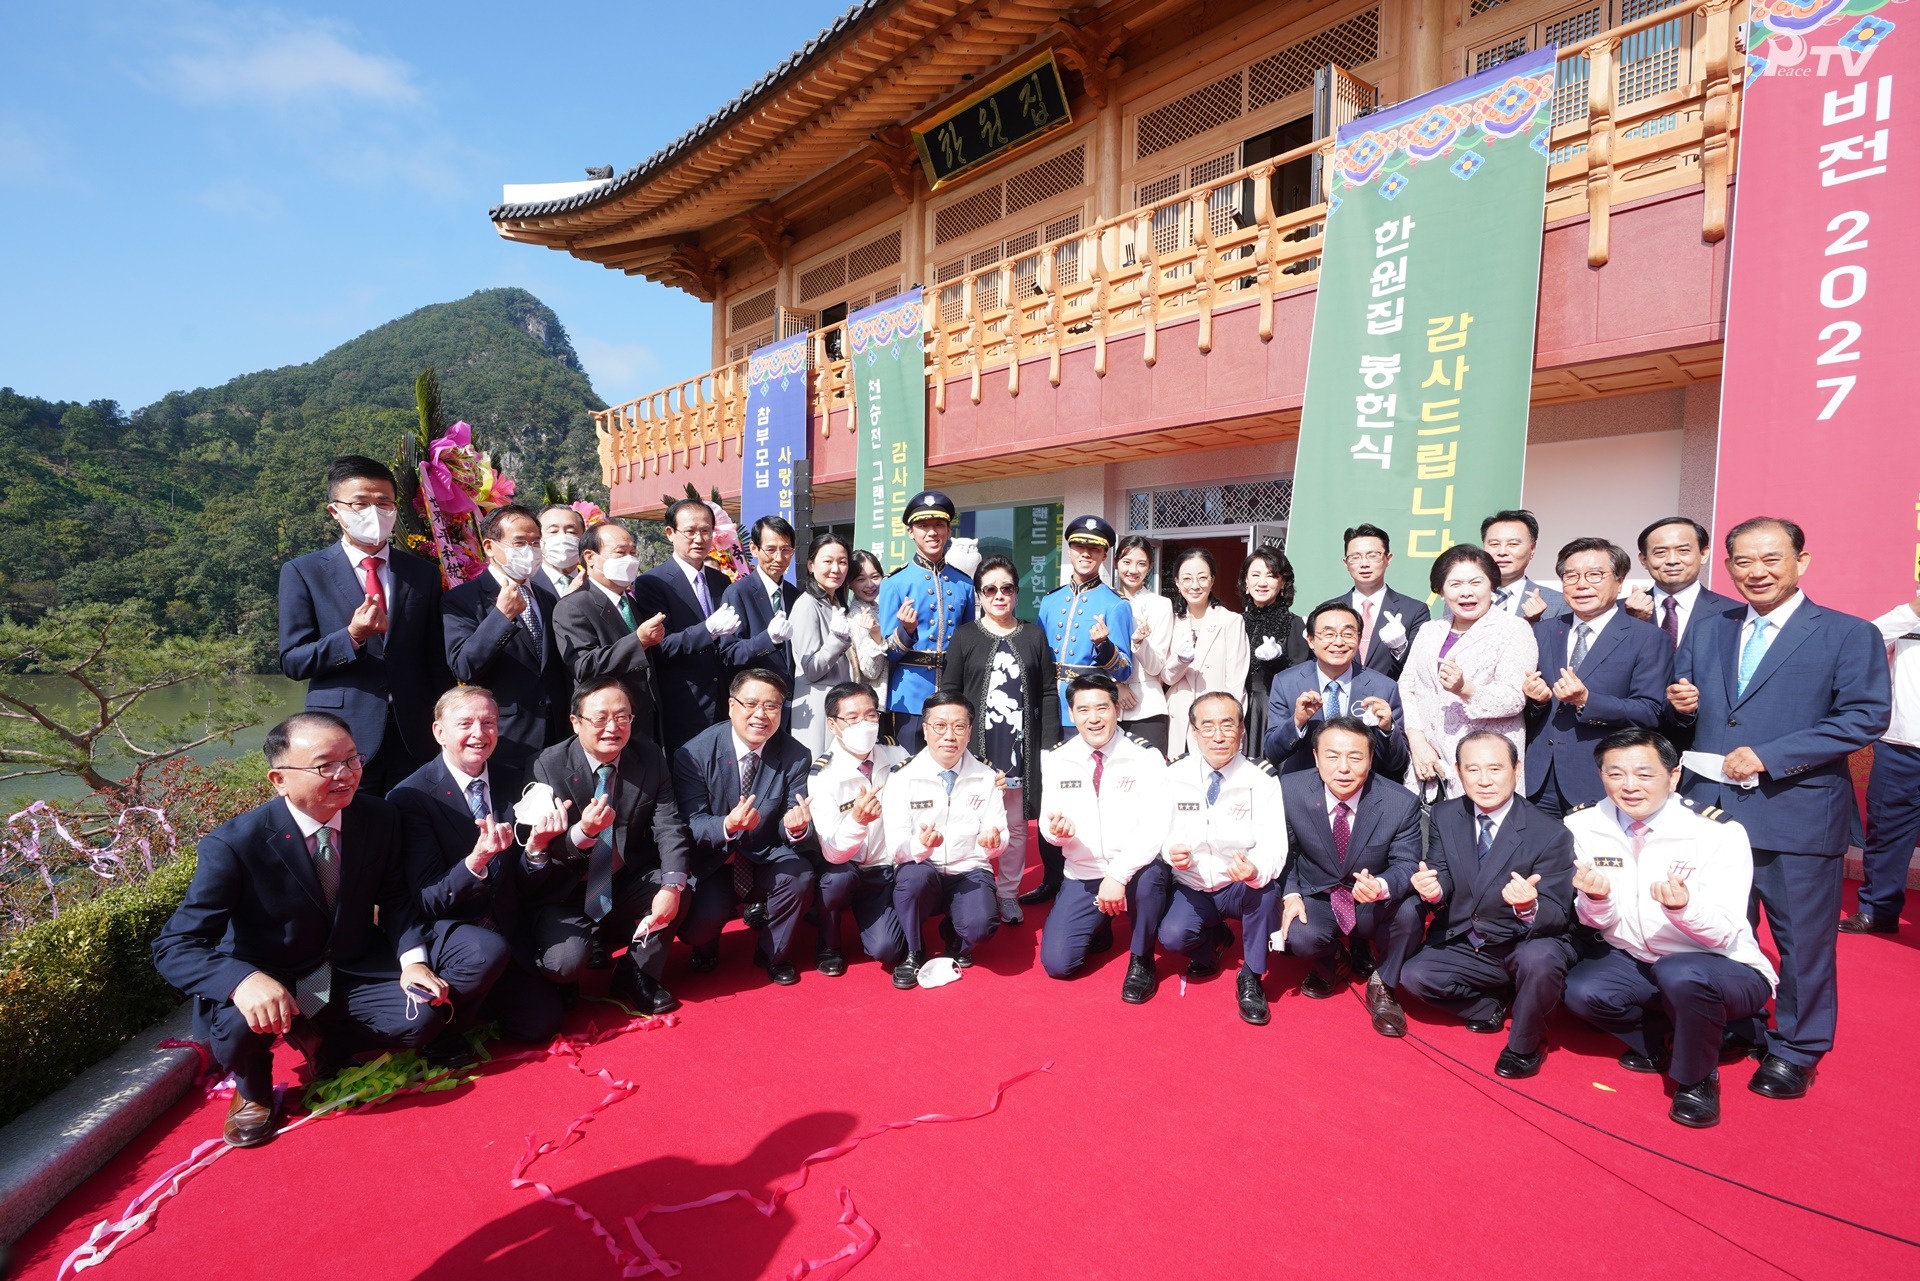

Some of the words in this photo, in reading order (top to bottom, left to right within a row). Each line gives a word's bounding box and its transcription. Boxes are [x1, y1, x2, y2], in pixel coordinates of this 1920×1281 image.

[1818, 75, 1893, 187] 비전
[1366, 215, 1416, 335] 한원집
[1816, 210, 1870, 421] 2027
[755, 406, 771, 489] 참부모님
[868, 378, 882, 450] 천승전
[1350, 353, 1401, 469] 봉헌식
[778, 446, 792, 528] 사랑합니
[872, 460, 885, 529] 그랜드
[890, 441, 908, 574] 감사드립니
